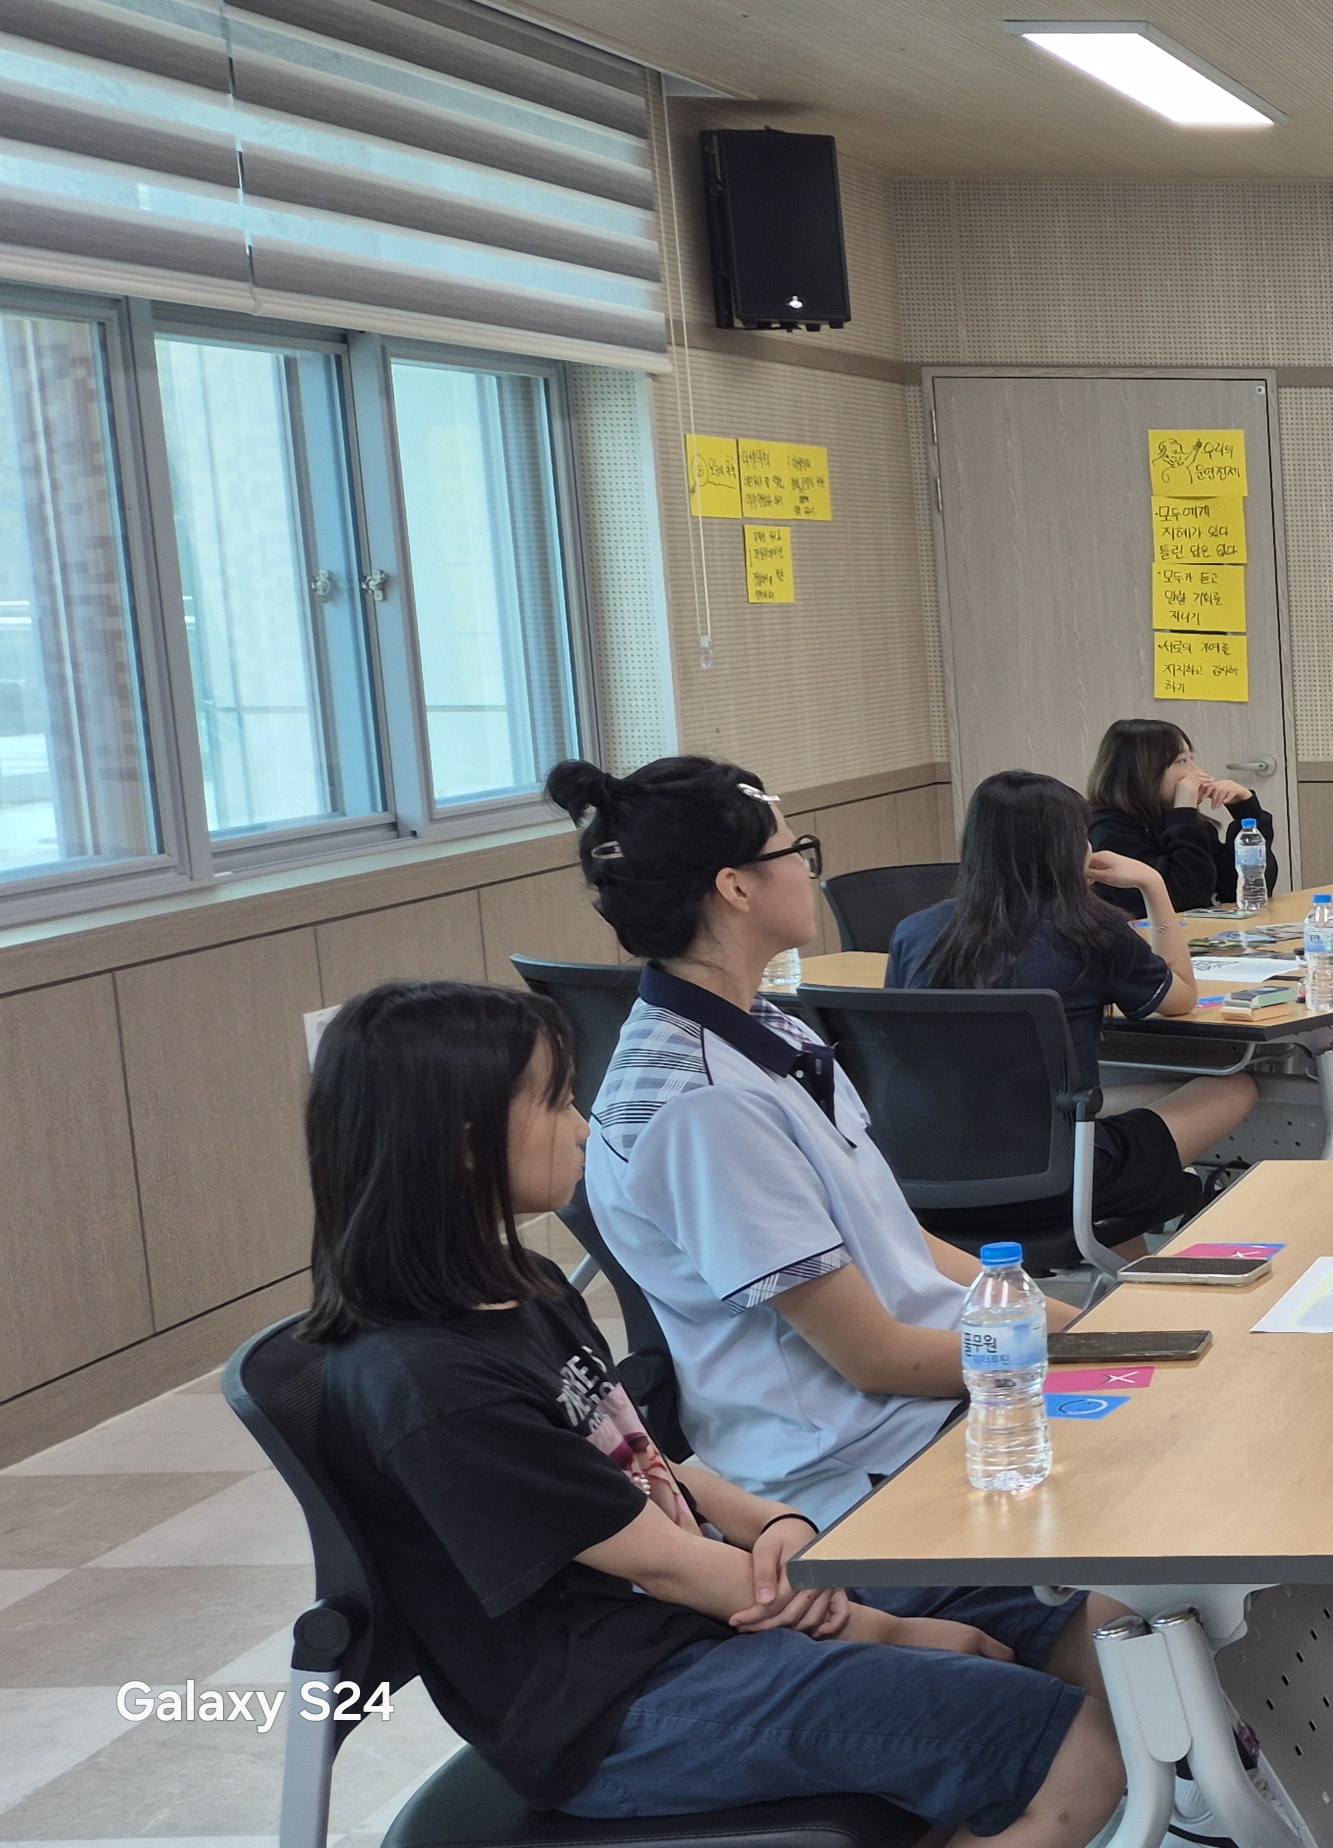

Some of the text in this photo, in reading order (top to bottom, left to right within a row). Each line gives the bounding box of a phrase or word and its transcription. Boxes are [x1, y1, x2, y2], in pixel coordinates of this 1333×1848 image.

[1202, 442, 1234, 459] 우리의
[1158, 505, 1210, 523] 모두에게
[1160, 545, 1184, 561] 틀린
[1163, 569, 1193, 584] 모두가
